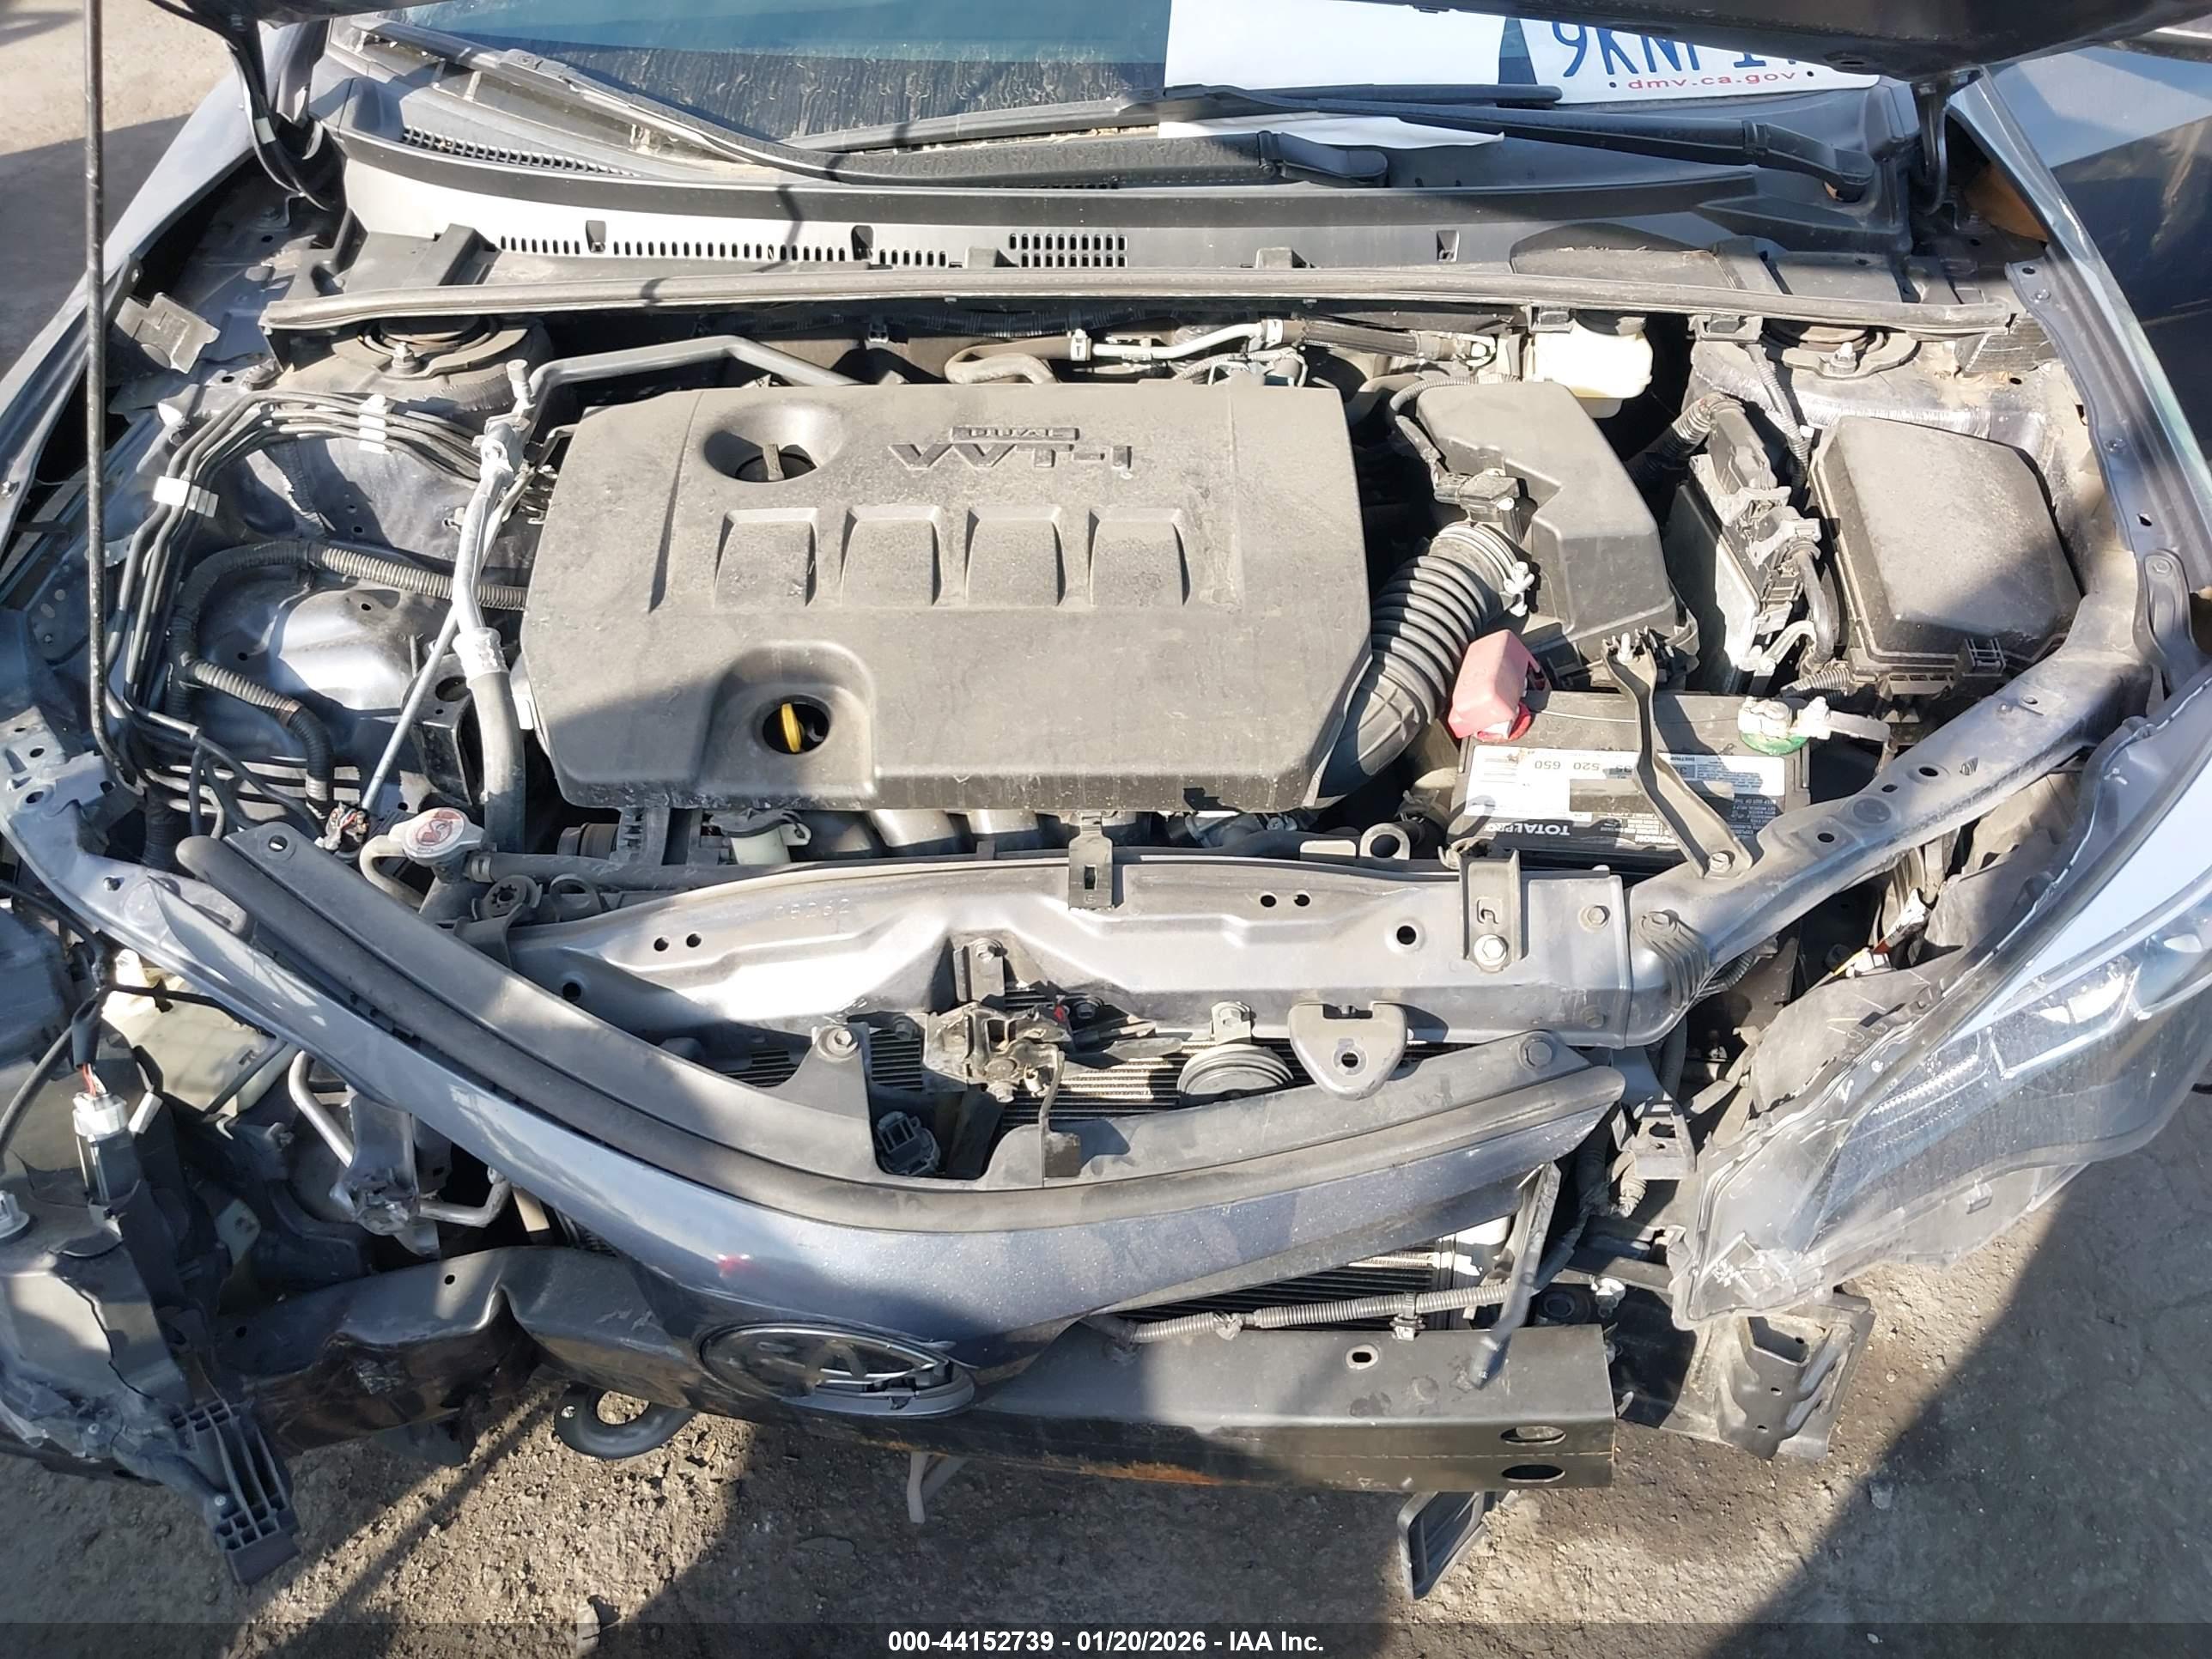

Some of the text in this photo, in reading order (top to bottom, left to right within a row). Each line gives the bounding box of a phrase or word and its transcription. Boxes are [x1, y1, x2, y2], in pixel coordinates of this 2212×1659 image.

[1552, 21, 1796, 77] 9KN
[1628, 71, 1796, 89] dmv.ca.gov
[969, 428, 1065, 437] DUAL
[1534, 760, 1562, 769] 650
[1573, 762, 1601, 771] 520
